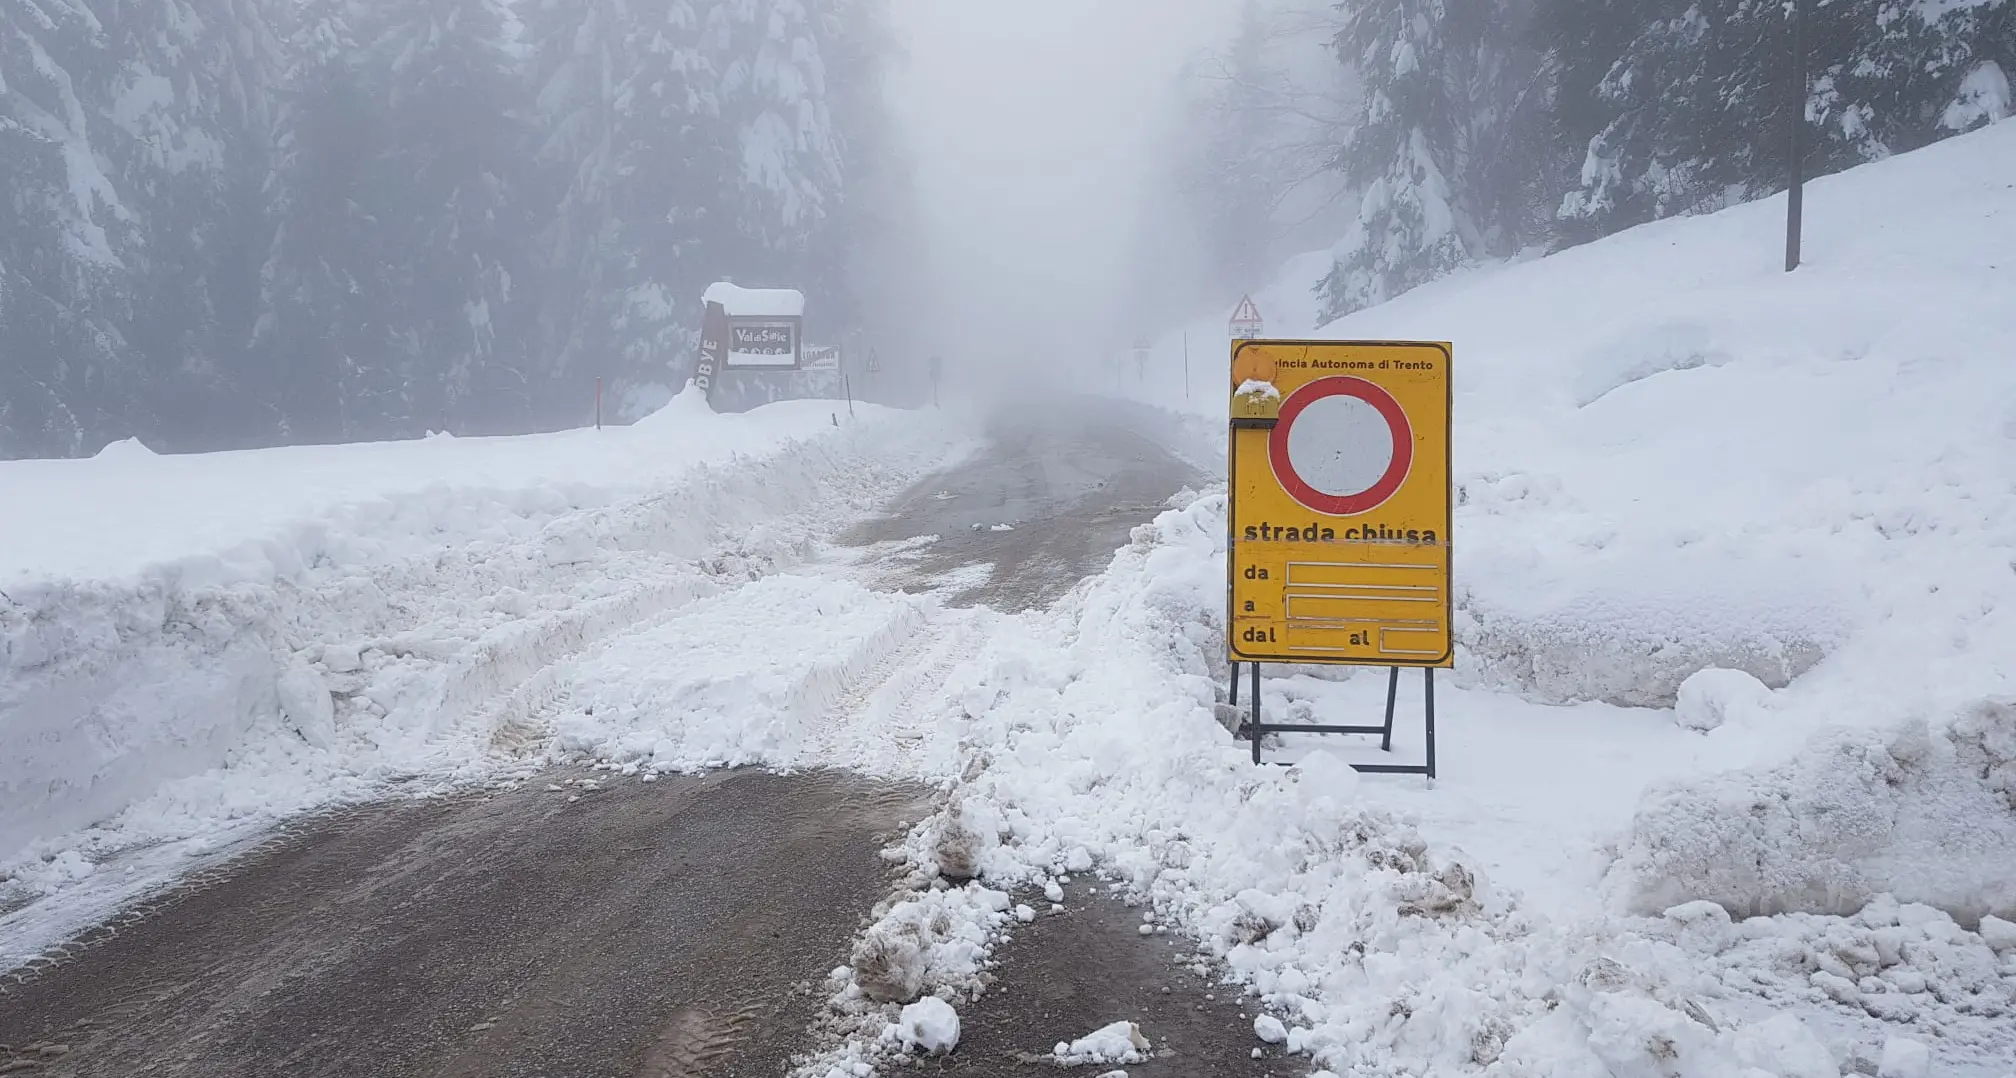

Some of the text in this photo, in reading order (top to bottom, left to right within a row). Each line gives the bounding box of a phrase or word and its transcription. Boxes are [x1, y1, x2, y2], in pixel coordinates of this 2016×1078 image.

[736, 329, 753, 342] Val
[696, 339, 717, 388] DBYE
[1275, 359, 1433, 370] incia Autonoma di Trento
[1244, 521, 1436, 545] strada chiusa
[1244, 565, 1269, 580] da
[1244, 600, 1255, 611] a
[1243, 627, 1369, 645] dal al
